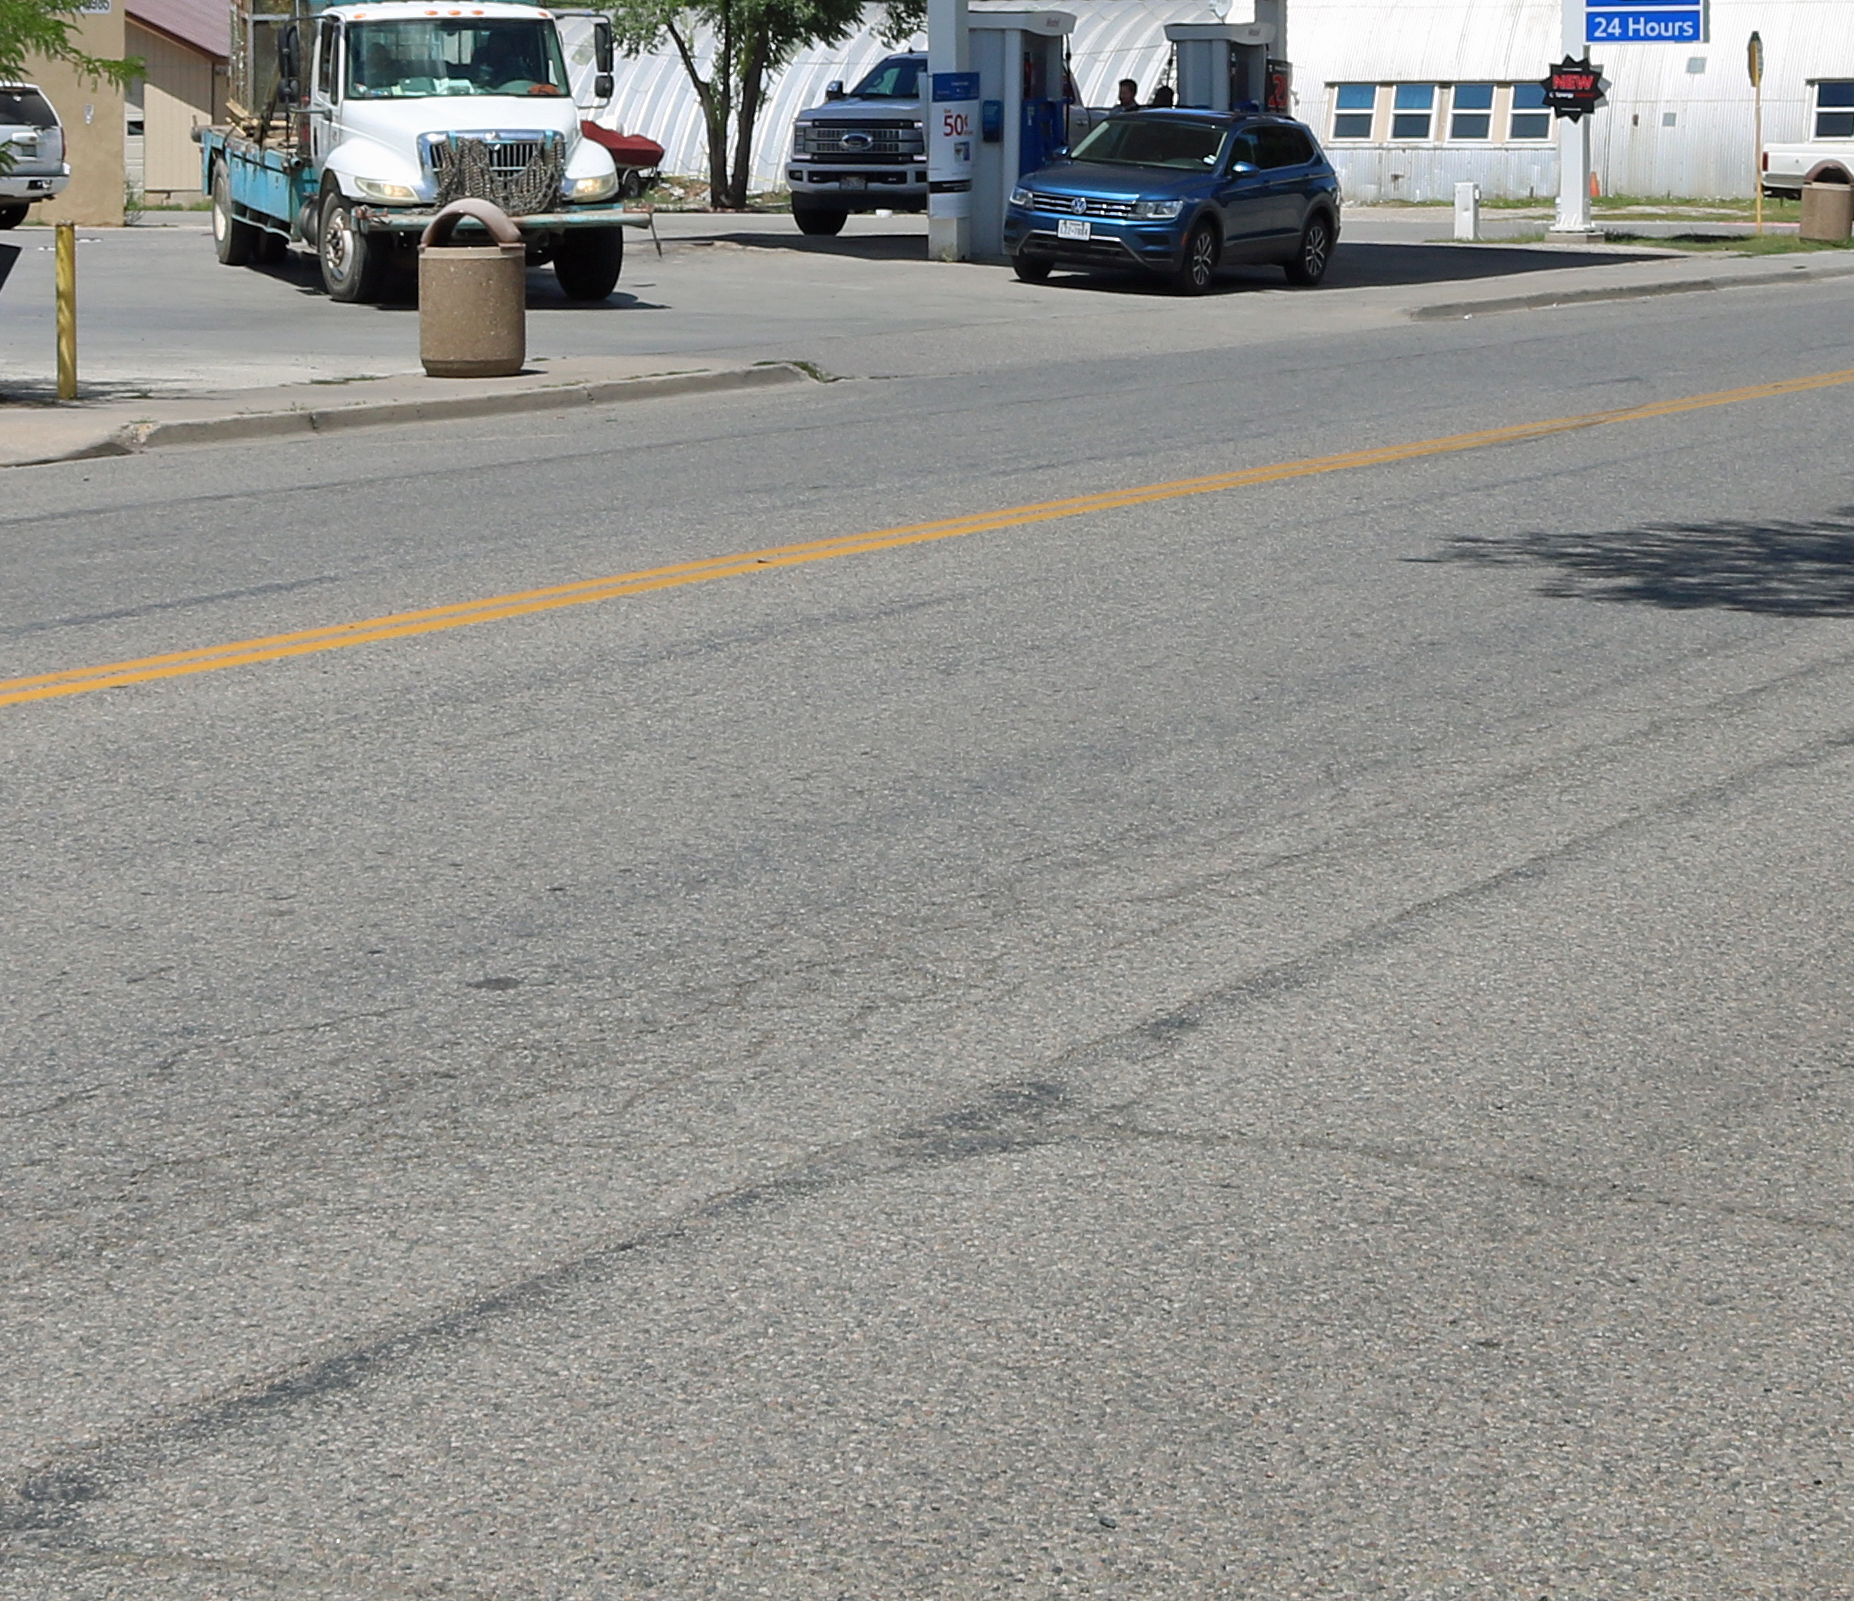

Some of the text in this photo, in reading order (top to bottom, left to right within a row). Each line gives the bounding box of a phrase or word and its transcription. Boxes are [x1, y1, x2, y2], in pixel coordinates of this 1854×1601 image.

[1594, 17, 1693, 37] 24 Hours
[1552, 75, 1595, 90] NEW
